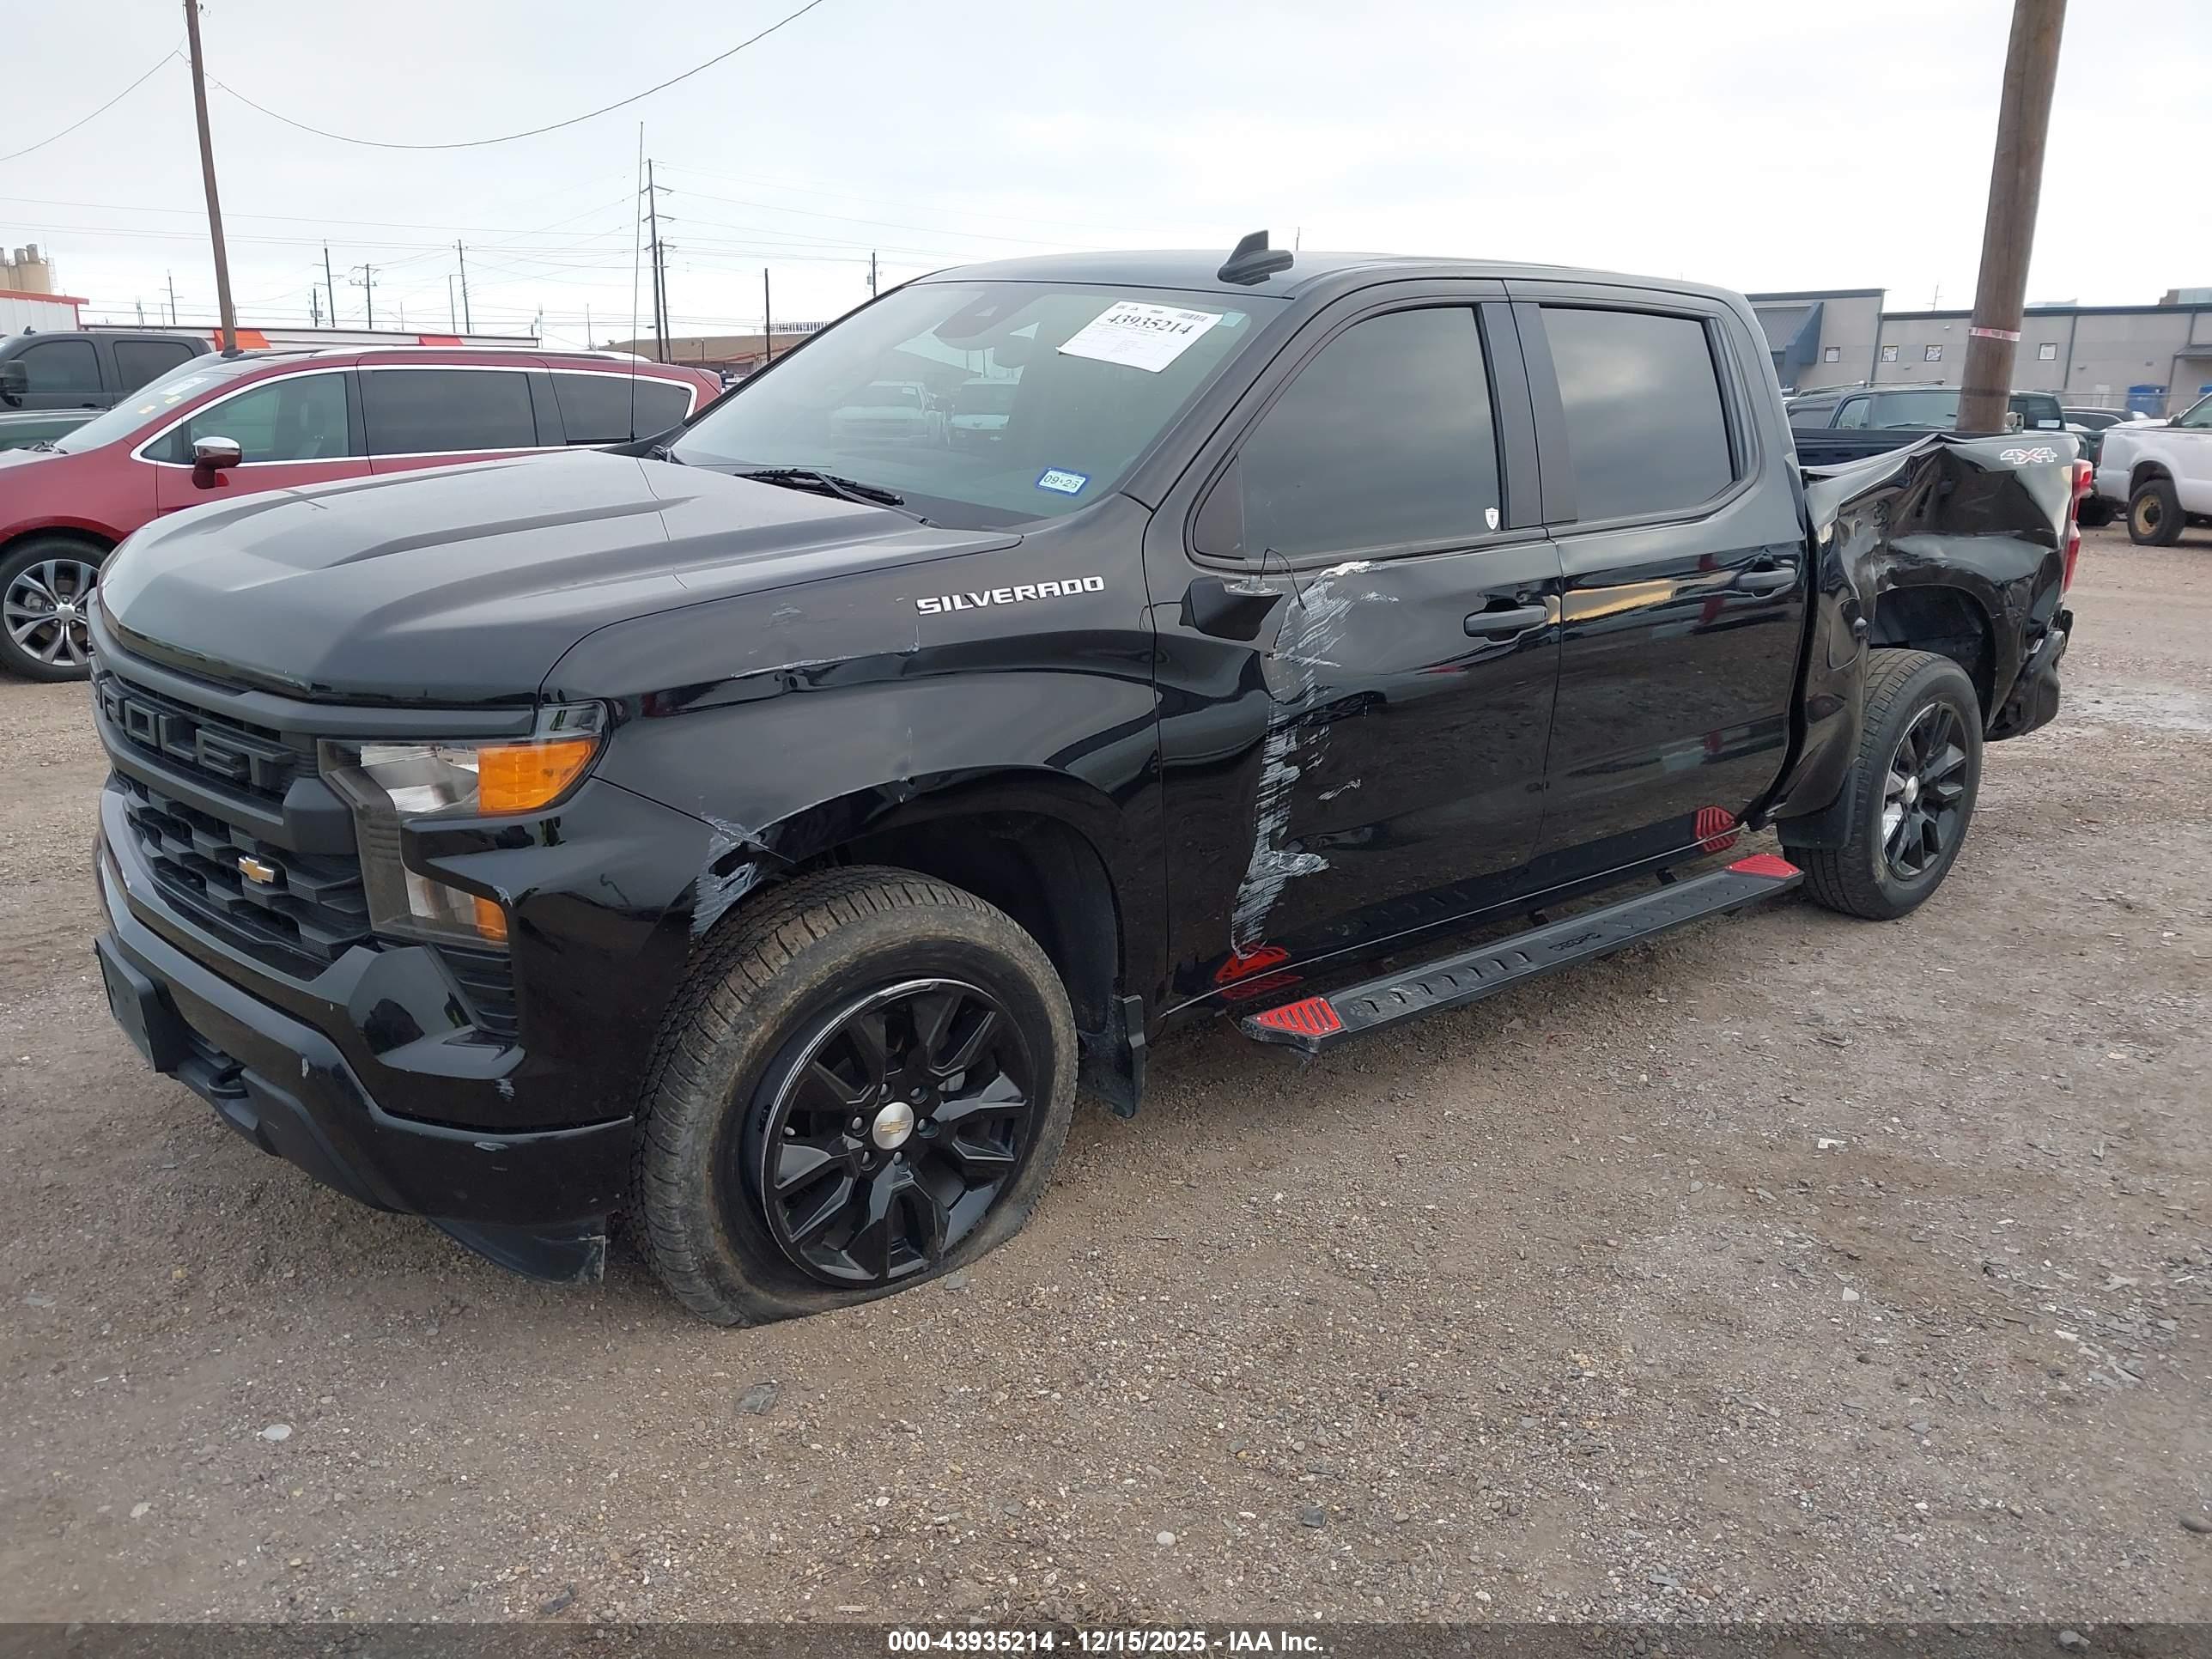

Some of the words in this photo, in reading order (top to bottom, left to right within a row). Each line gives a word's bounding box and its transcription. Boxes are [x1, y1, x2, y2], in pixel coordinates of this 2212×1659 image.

[1107, 313, 1194, 335] 43935214
[916, 575, 1106, 616] SILVERADO
[100, 679, 294, 788] ROLET
